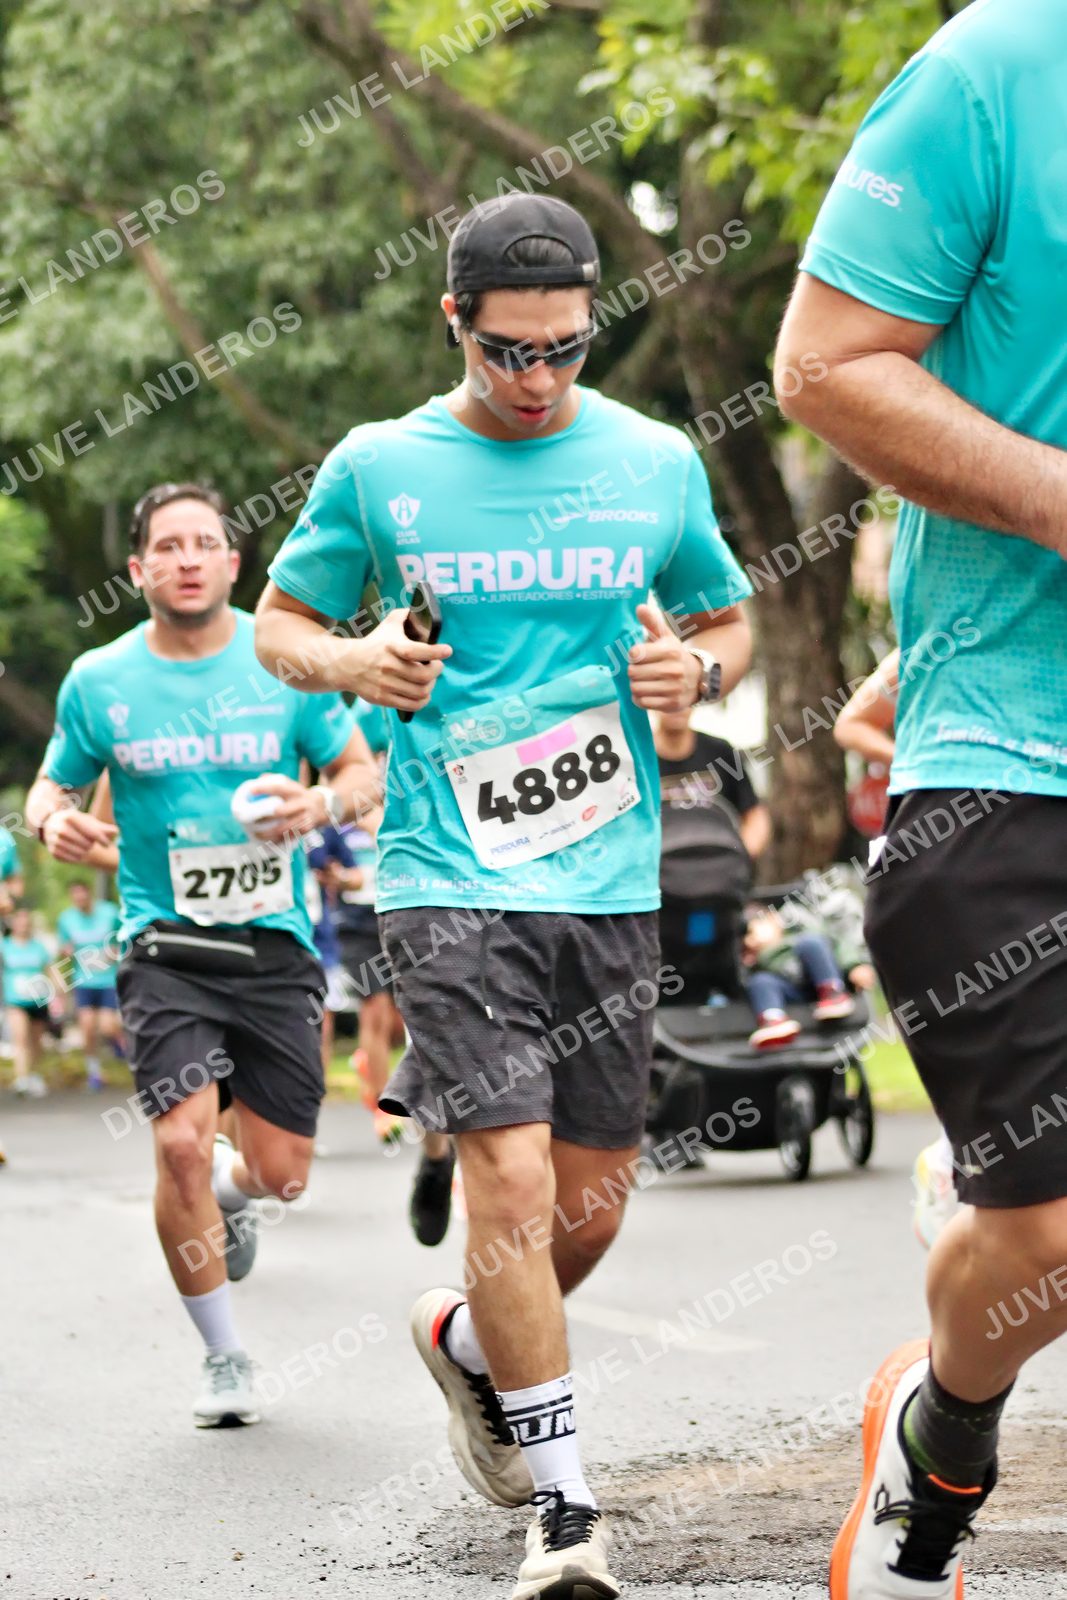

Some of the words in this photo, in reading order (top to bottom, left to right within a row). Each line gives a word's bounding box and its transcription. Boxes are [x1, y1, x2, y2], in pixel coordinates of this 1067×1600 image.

[587, 509, 659, 524] BROOKS
[395, 547, 645, 594] PERDURA
[112, 731, 282, 772] PERDURA
[477, 734, 620, 825] 4888
[183, 857, 281, 899] 2705
